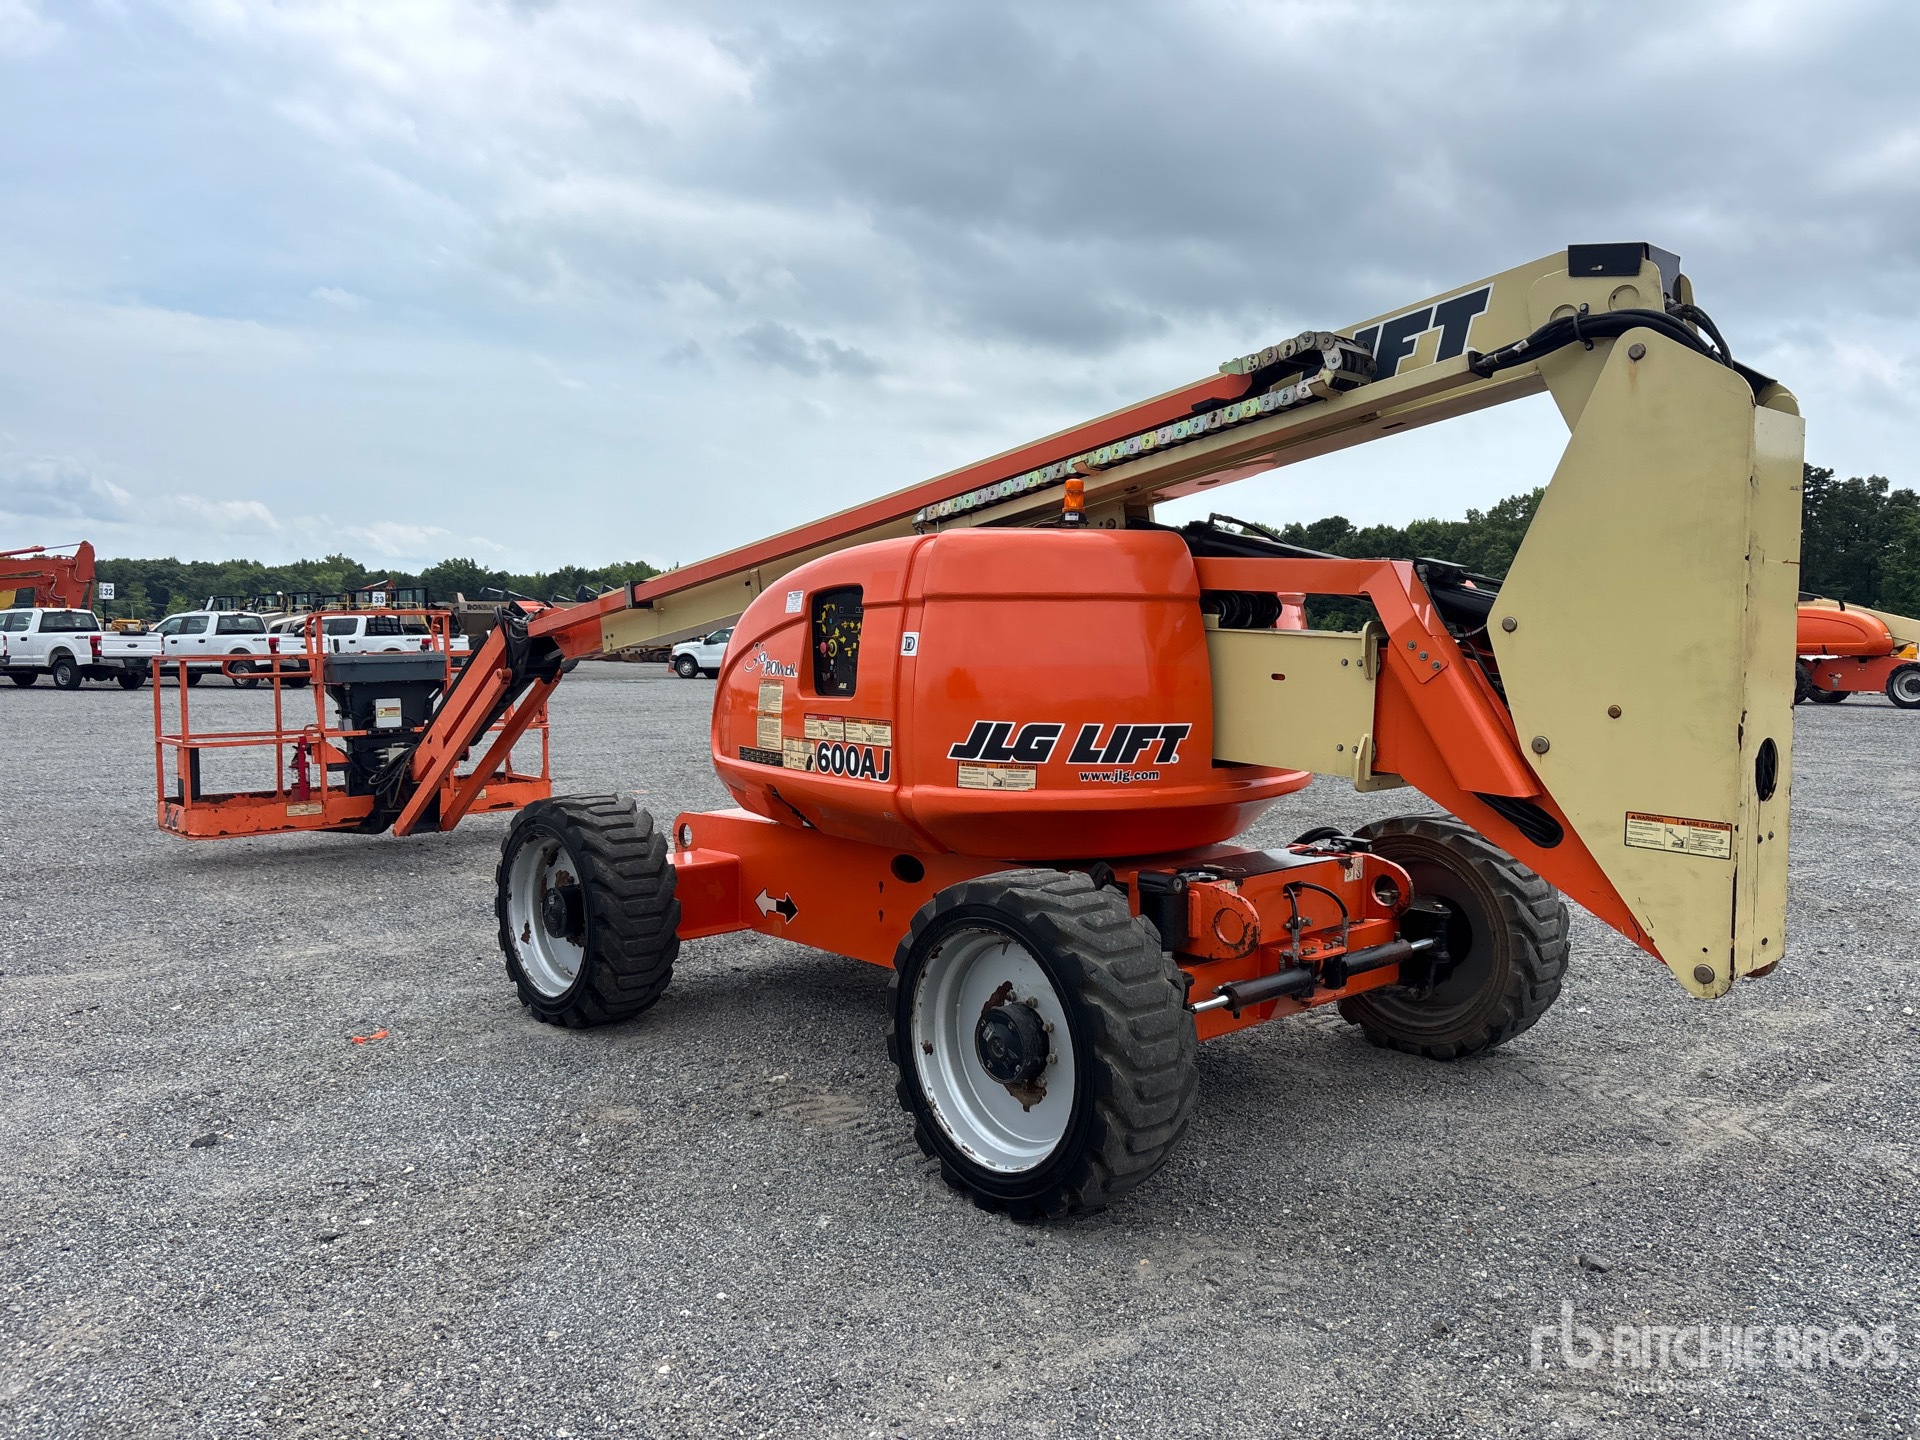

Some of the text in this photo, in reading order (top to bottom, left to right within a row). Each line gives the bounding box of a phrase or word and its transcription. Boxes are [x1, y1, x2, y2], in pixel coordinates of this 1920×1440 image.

[103, 588, 113, 596] 32
[374, 596, 384, 604] 33
[948, 721, 1192, 764] JLG LIFT
[816, 741, 891, 782] 600AJ
[1080, 769, 1159, 783] www.jlg.com
[1636, 815, 1664, 823] WARNING
